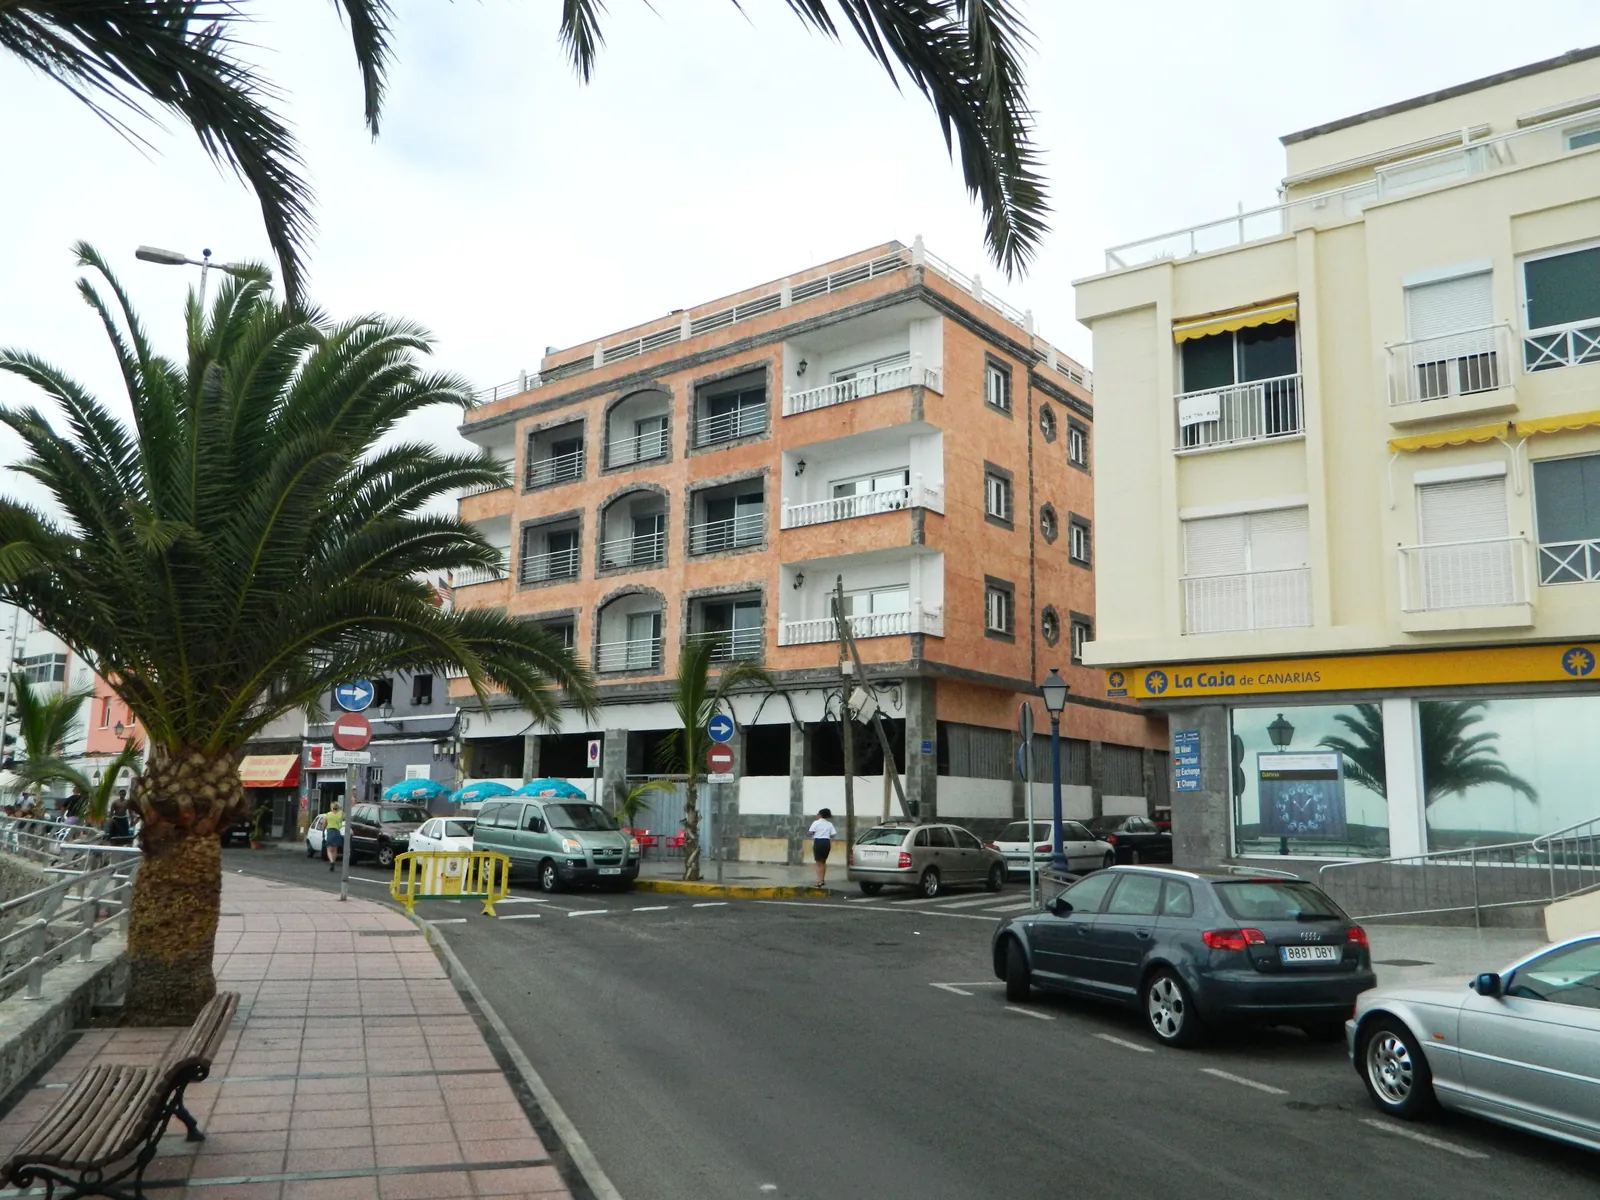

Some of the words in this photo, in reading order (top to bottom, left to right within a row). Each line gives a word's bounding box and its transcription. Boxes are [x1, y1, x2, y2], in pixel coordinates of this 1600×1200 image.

[1174, 674, 1193, 688] La
[1197, 671, 1235, 688] Caja
[1239, 675, 1254, 686] de
[1257, 671, 1321, 685] CANARIAS
[1181, 767, 1200, 777] Exchange
[1181, 779, 1197, 789] Change
[1288, 947, 1312, 959] 8881
[1315, 947, 1333, 959] DBY
